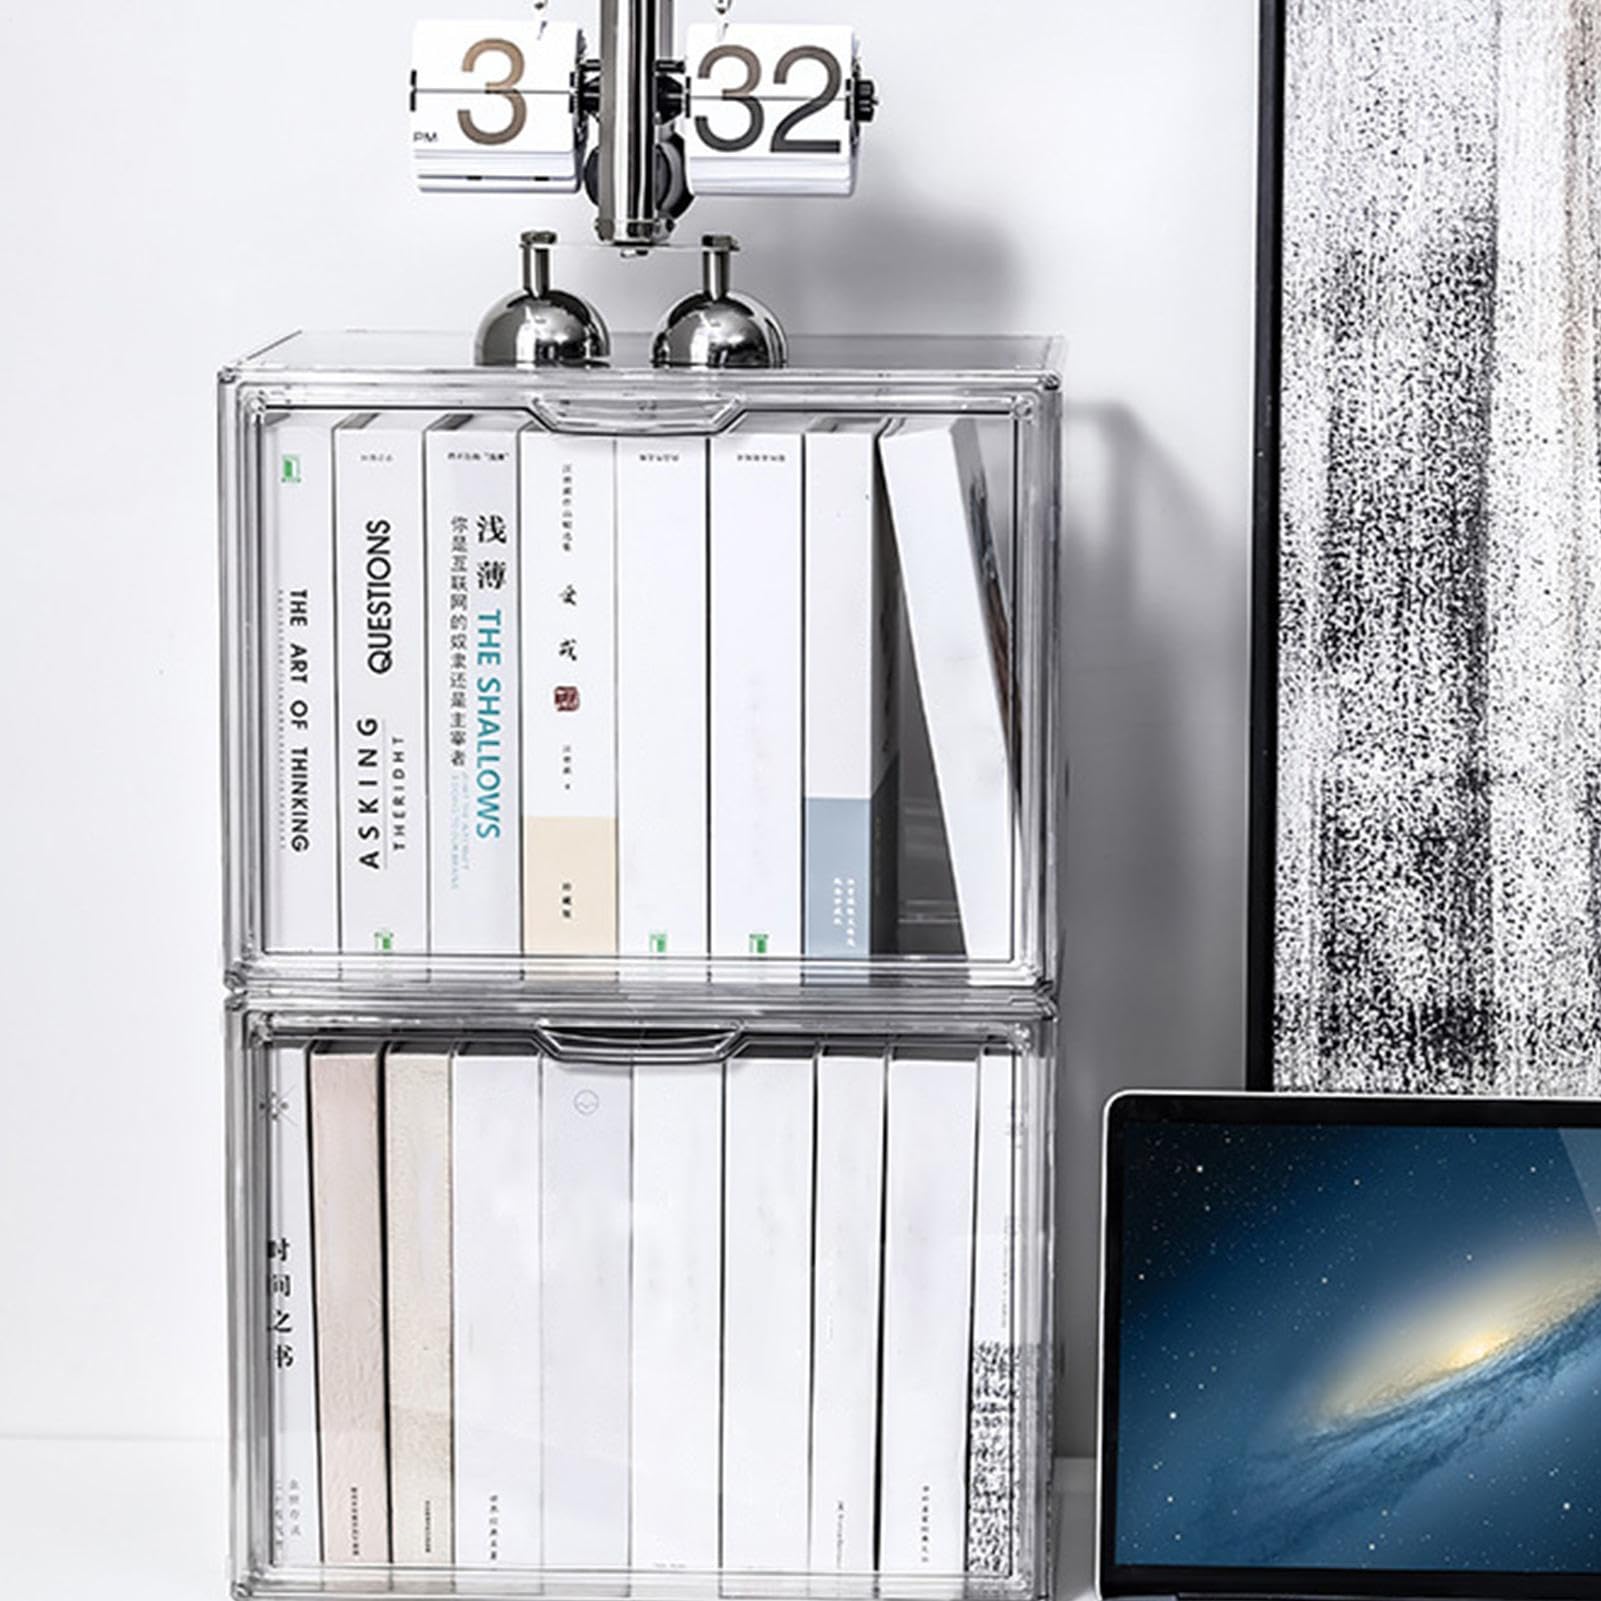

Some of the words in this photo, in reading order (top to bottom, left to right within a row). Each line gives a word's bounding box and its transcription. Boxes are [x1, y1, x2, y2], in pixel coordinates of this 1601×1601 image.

[413, 131, 439, 143] PM
[456, 37, 527, 146] 3
[694, 44, 843, 154] 32
[366, 518, 394, 675] QUESTIONS
[476, 514, 508, 591] 浅薄
[289, 588, 308, 627] THE
[477, 608, 502, 667] THE
[289, 641, 309, 684] ART
[289, 699, 309, 730] OF
[476, 676, 502, 840] SHALLOWS
[290, 746, 310, 853] THINKING
[355, 716, 381, 871] ASKING
